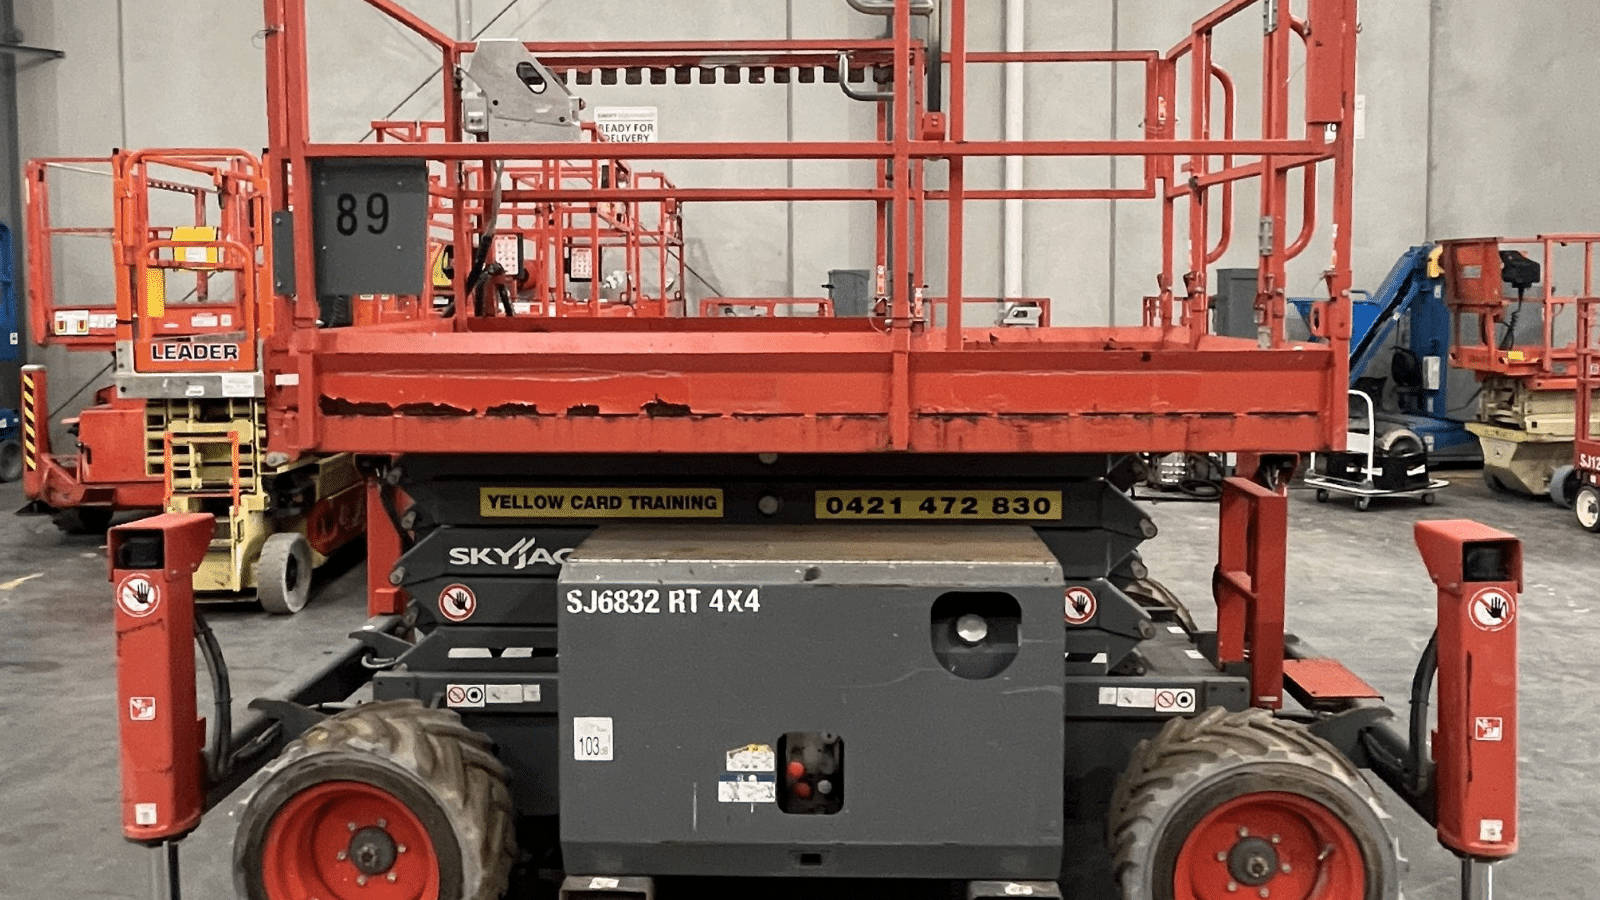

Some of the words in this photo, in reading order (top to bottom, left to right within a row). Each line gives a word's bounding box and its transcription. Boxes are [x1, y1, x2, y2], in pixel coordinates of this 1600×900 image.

[598, 123, 631, 132] READY
[634, 123, 654, 132] FOR
[603, 134, 649, 143] DELIVERY
[337, 192, 389, 237] 89
[151, 343, 239, 360] LEADER
[487, 495, 564, 511] YELLOW
[570, 495, 623, 511] CARD
[627, 495, 718, 511] TRAINING
[825, 496, 903, 515] 0421
[918, 496, 978, 515] 472
[991, 496, 1052, 515] 830
[566, 589, 660, 614] SJ6832
[668, 589, 702, 613] RT
[708, 588, 761, 613] 4X4
[579, 736, 600, 756] 103
